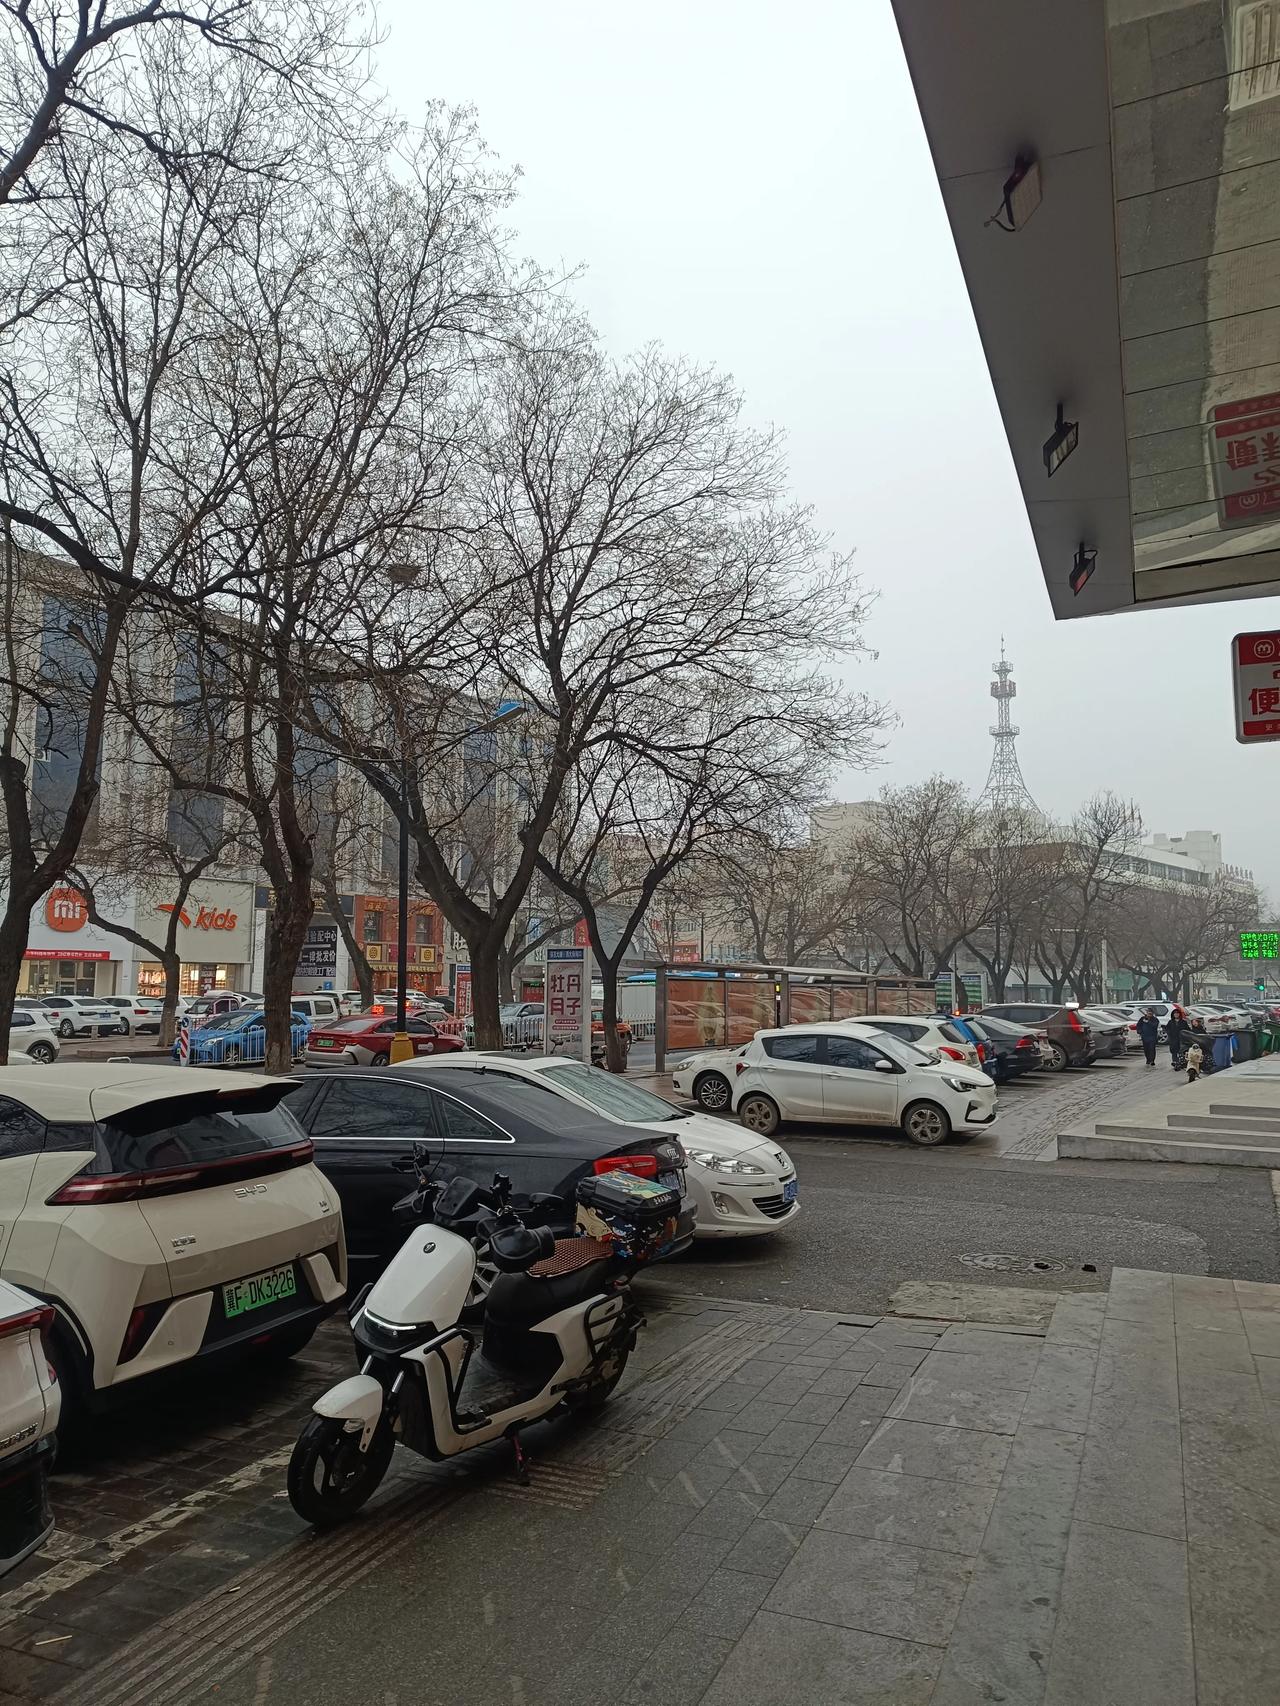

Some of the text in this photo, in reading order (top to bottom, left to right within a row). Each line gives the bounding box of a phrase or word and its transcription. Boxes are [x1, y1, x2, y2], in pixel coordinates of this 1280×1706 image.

[196, 905, 238, 931] kids
[550, 974, 581, 993] 牡丹
[550, 997, 581, 1016] 月子
[234, 1184, 267, 1198] BYD
